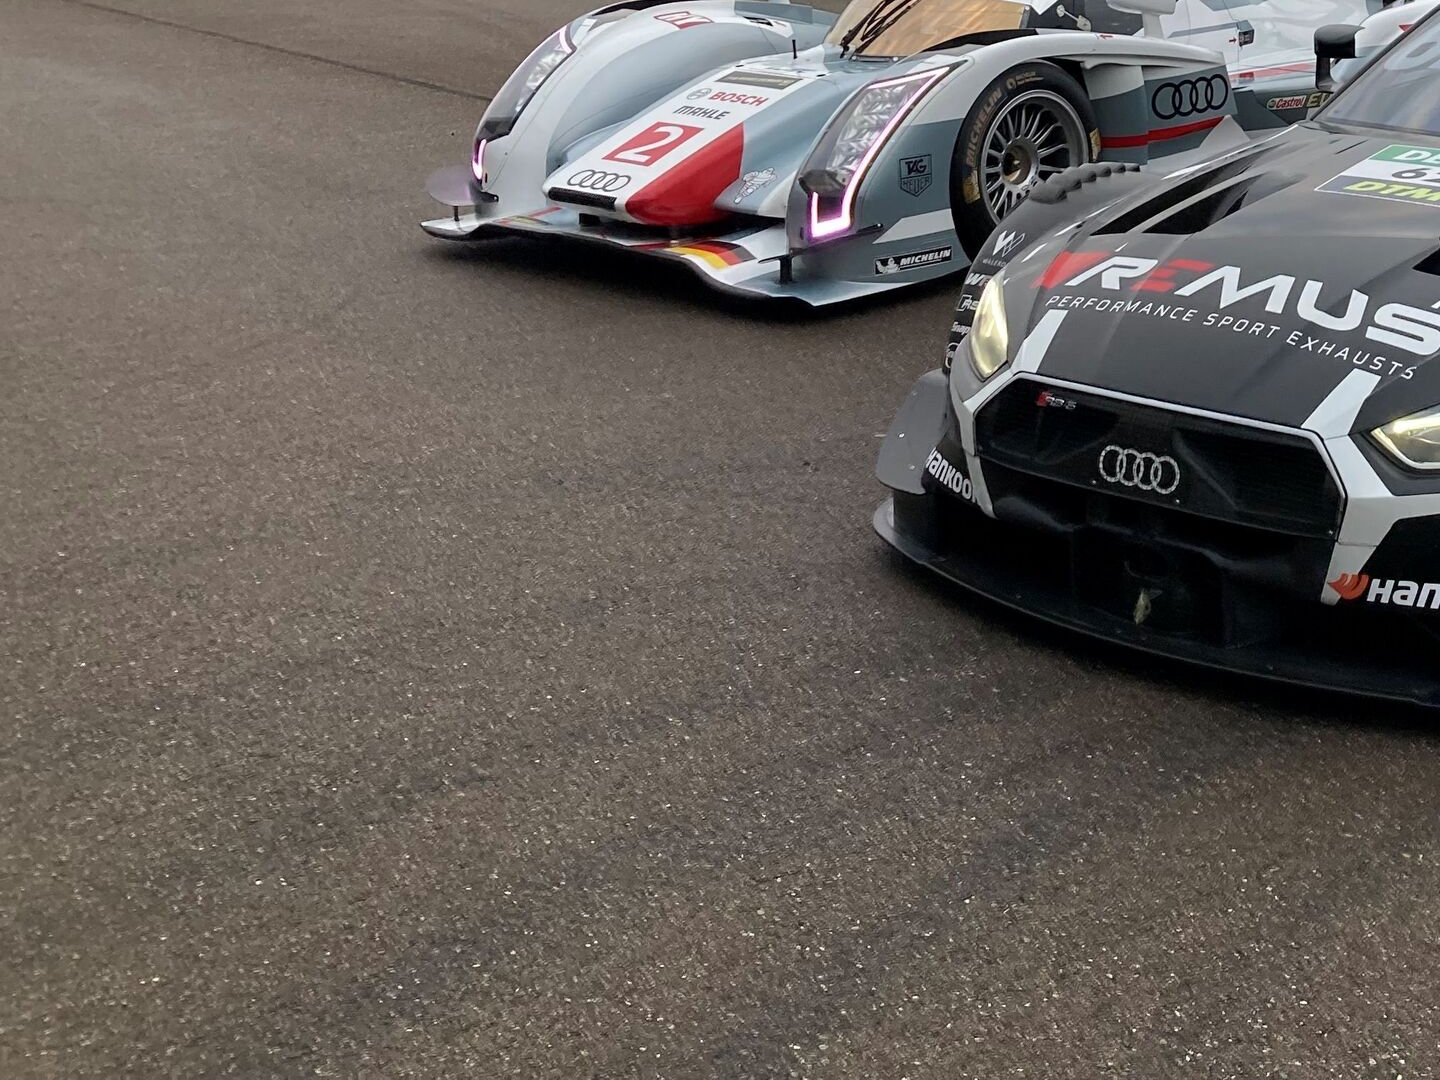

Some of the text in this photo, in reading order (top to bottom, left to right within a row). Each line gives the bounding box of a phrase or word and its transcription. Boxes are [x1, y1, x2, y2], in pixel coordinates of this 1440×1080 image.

[708, 91, 769, 107] BOSCH
[1275, 96, 1306, 108] Castrol
[673, 105, 730, 121] MAHLE
[613, 125, 685, 163] 2
[904, 158, 927, 176] TAG
[899, 248, 952, 266] MICHELIN
[1045, 295, 1419, 380] PERFORMANCE SPORT EXHAUSTS
